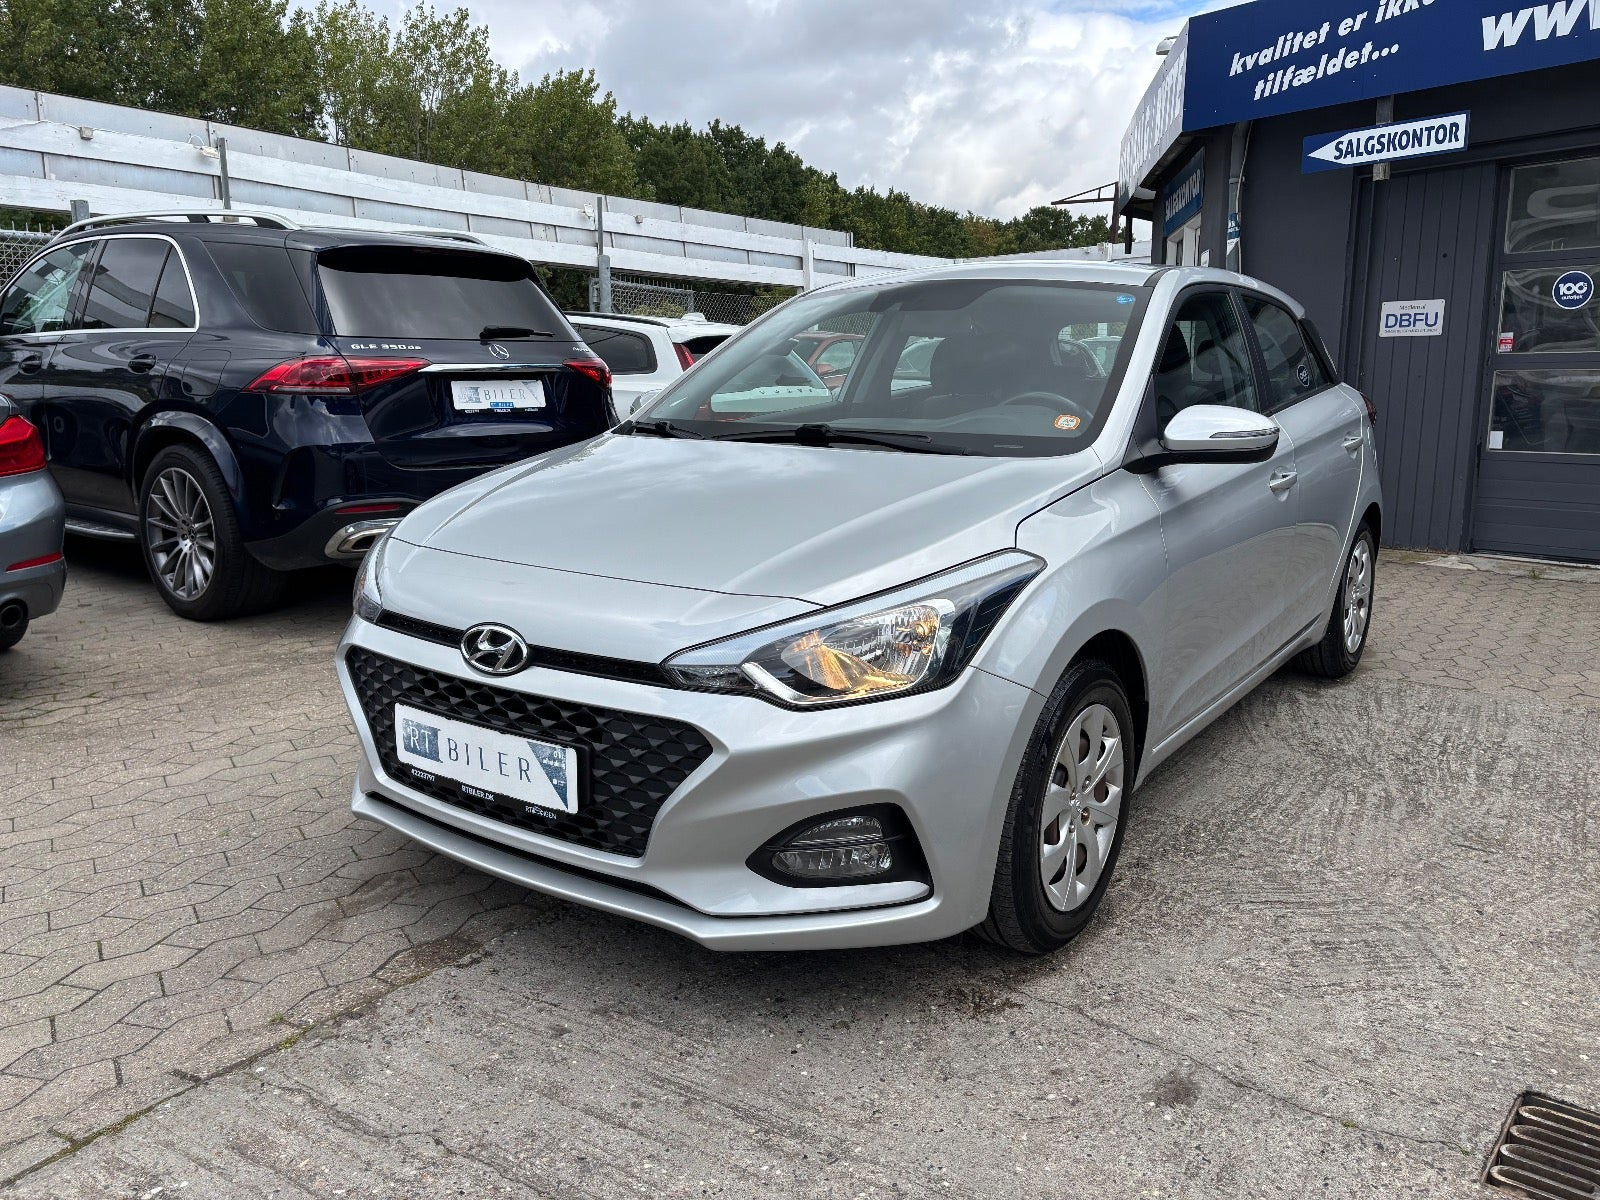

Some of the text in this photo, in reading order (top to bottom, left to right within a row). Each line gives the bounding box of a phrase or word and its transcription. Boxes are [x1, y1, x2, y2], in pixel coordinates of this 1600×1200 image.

[1229, 0, 1436, 77] kvalitet er ikk
[1254, 41, 1400, 101] tilfældet...
[1334, 121, 1460, 160] SALGSKONTOR
[1384, 312, 1439, 328] DBFU
[484, 388, 526, 400] BILER
[409, 726, 532, 783] RT BILER
